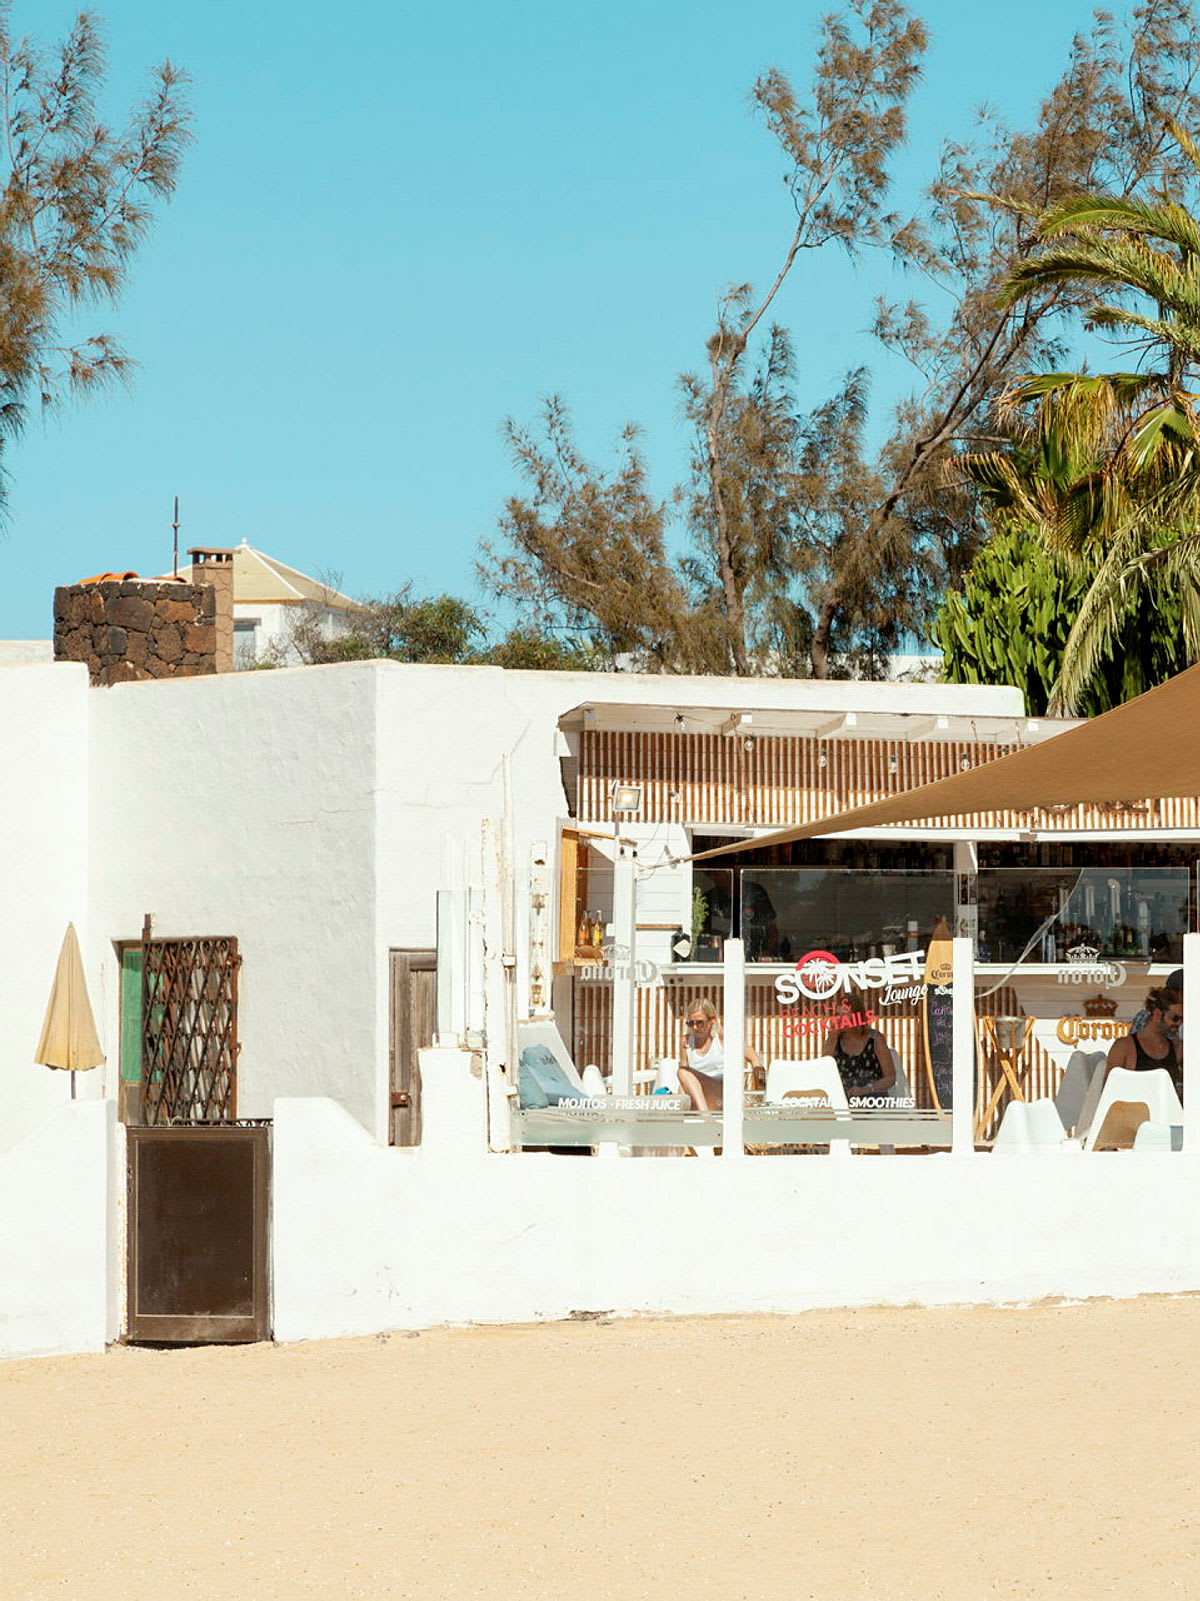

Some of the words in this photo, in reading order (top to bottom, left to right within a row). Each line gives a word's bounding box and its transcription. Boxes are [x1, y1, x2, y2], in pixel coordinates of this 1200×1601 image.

[879, 984, 928, 1006] Lounge
[780, 1002, 837, 1018] BEACH
[840, 998, 852, 1013] &
[782, 1010, 876, 1038] COCKTAILS
[1056, 1014, 1133, 1049] Coron
[558, 1097, 606, 1109] MOJITOS
[615, 1099, 649, 1110] FRESH
[649, 1099, 681, 1110] JUICE
[849, 1096, 916, 1109] SMOOTHIES
